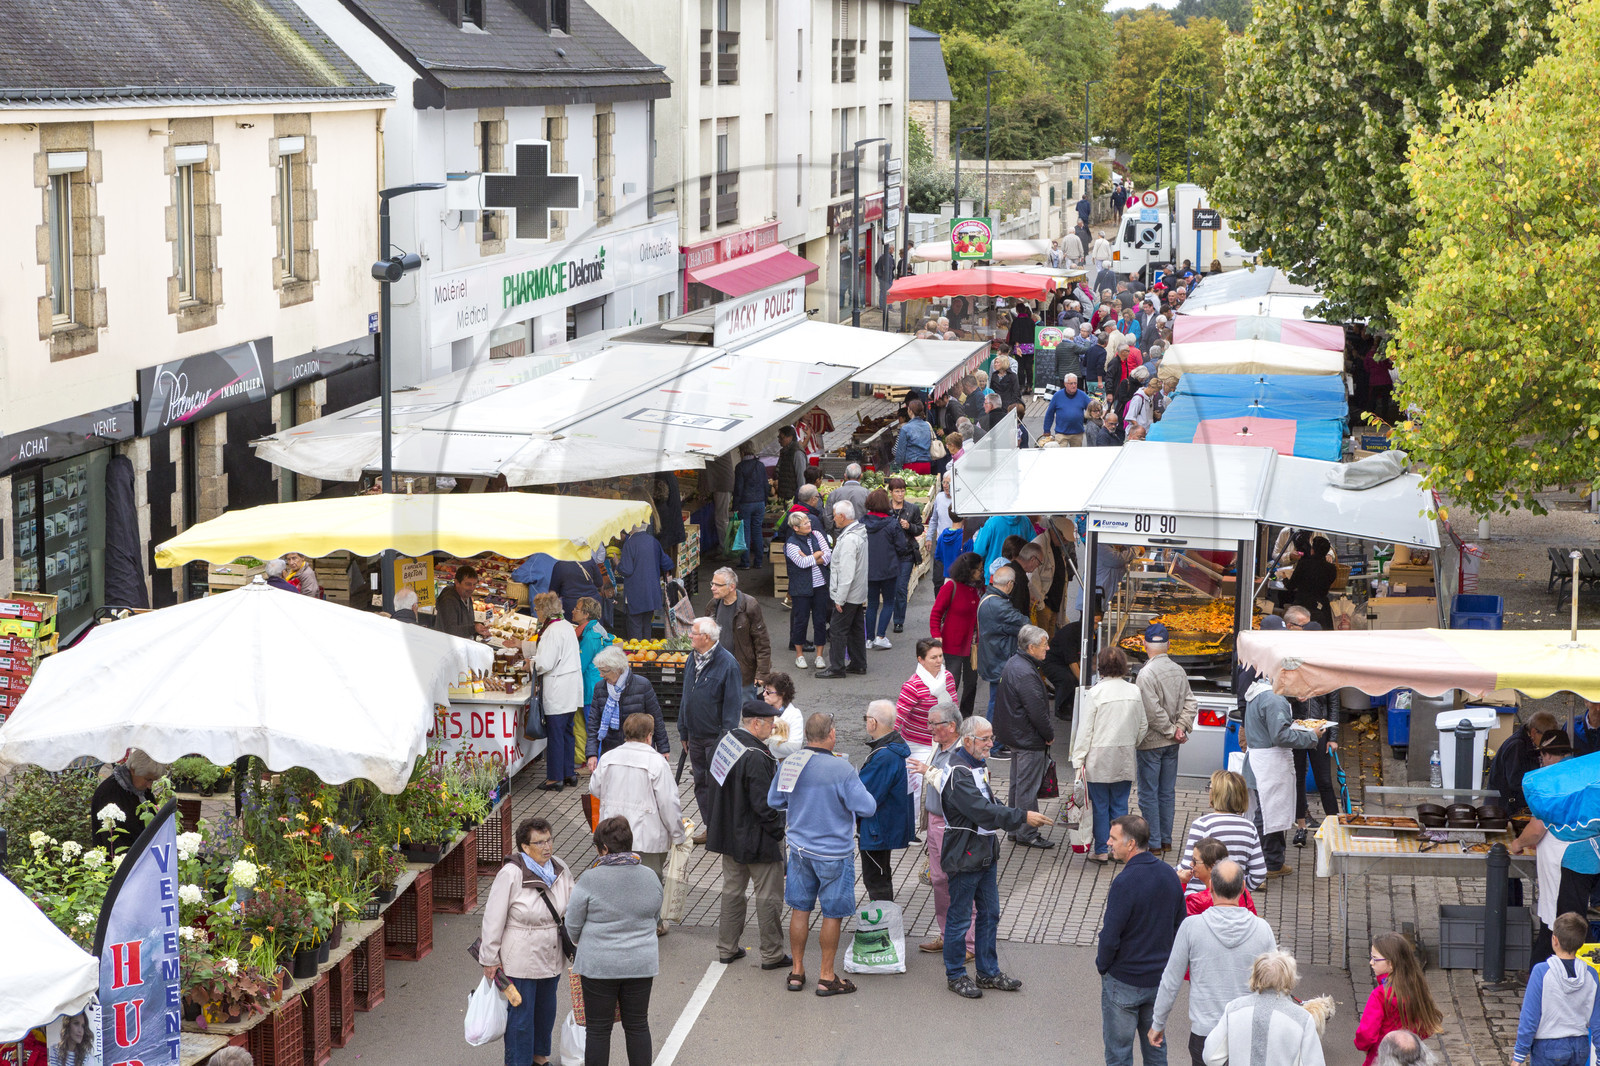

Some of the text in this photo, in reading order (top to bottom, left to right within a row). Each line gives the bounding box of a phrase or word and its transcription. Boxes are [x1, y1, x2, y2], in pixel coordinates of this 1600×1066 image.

[640, 237, 672, 262] Orthopédie
[434, 279, 467, 306] Matériel
[503, 254, 603, 309] PHARMACIE Delcroix
[457, 303, 488, 330] Médical
[292, 360, 320, 380] LOCATION
[220, 377, 261, 399] IMMOBILIER
[93, 417, 117, 437] VENTE
[19, 437, 48, 460] ACHAT
[1135, 514, 1177, 534] 80 90
[471, 711, 495, 738] DE
[503, 709, 518, 738] LA
[871, 953, 893, 963] terre
[109, 939, 145, 1066] HU
[94, 1006, 102, 1063] Armor-lux
